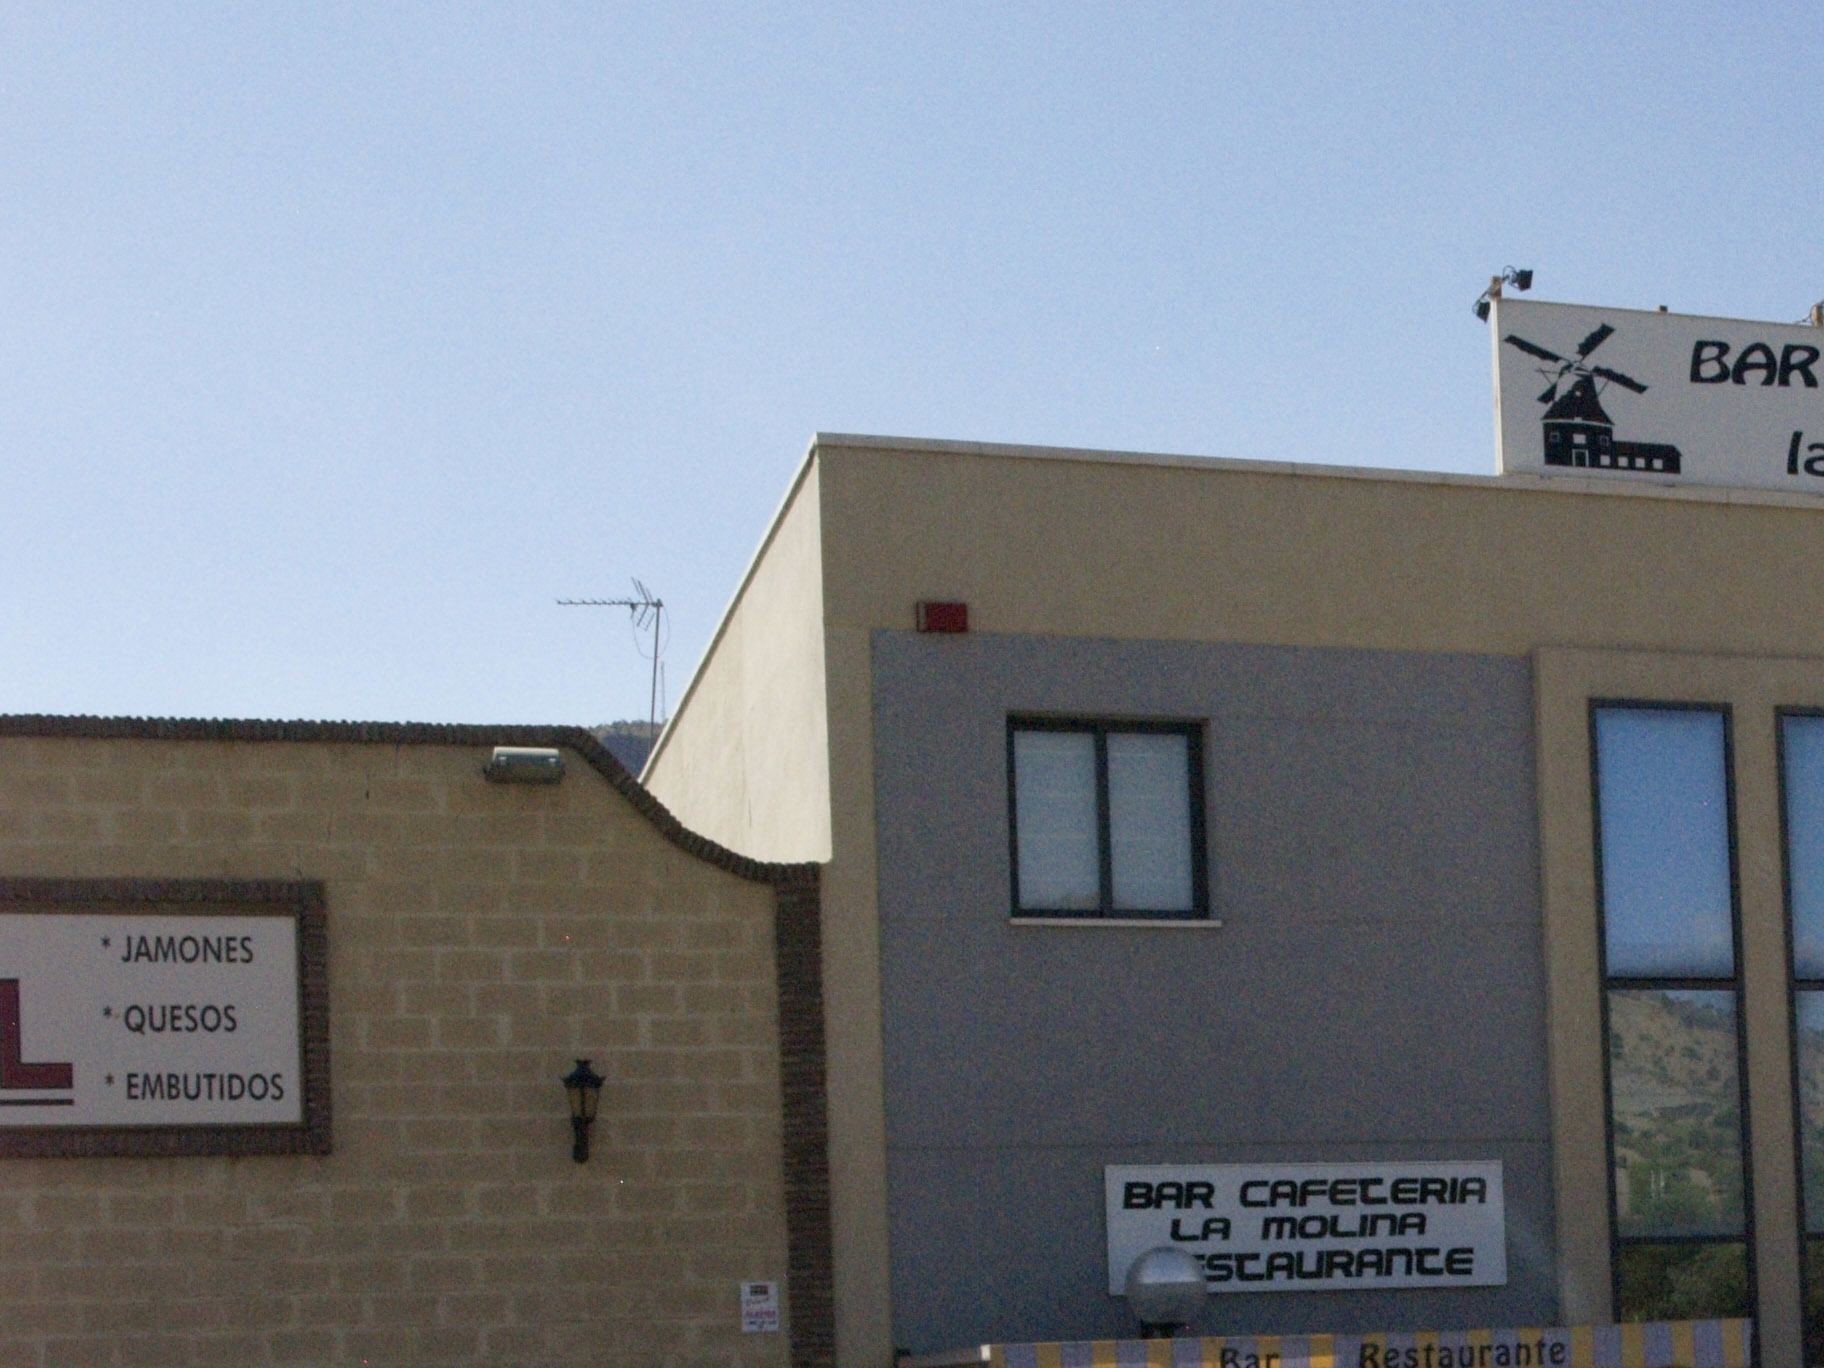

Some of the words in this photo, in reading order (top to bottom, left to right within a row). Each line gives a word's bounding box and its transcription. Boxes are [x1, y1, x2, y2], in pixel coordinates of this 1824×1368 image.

[1690, 340, 1819, 387] BAR
[121, 935, 254, 963] JAMONES
[124, 1004, 238, 1035] QUESOS
[126, 1073, 285, 1101] EMBUTIDOS
[1122, 1181, 1215, 1210] BAR
[1238, 1177, 1487, 1208] CAFETERIA
[1170, 1217, 1231, 1242] LA
[1261, 1212, 1427, 1240] MOLINA
[1192, 1247, 1474, 1282] STAURANTE
